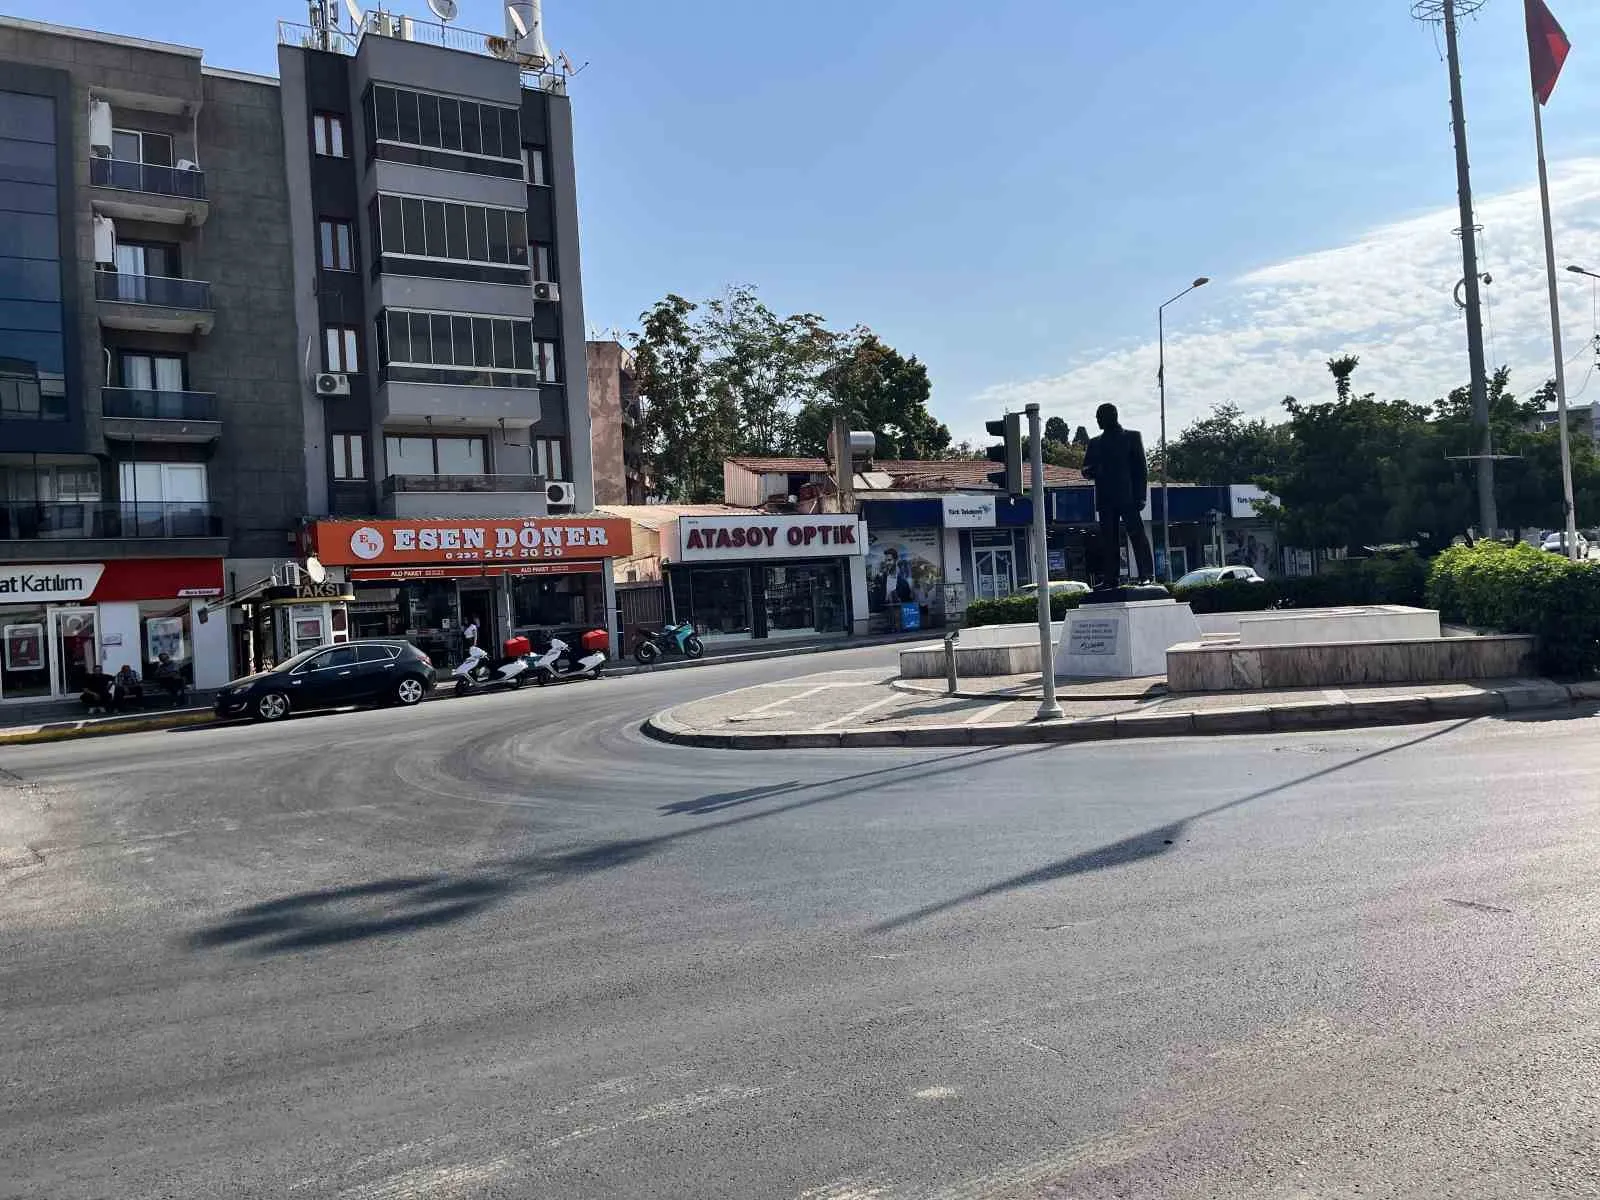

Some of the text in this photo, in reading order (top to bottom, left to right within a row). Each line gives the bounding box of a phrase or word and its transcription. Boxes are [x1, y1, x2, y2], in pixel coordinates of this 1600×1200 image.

[393, 520, 609, 551] ESEN DÖNER
[687, 526, 778, 550] ATASOY
[445, 552, 453, 560] 0
[484, 548, 513, 559] 254
[520, 548, 538, 557] 50
[544, 547, 563, 557] 50
[21, 574, 83, 593] Katılım
